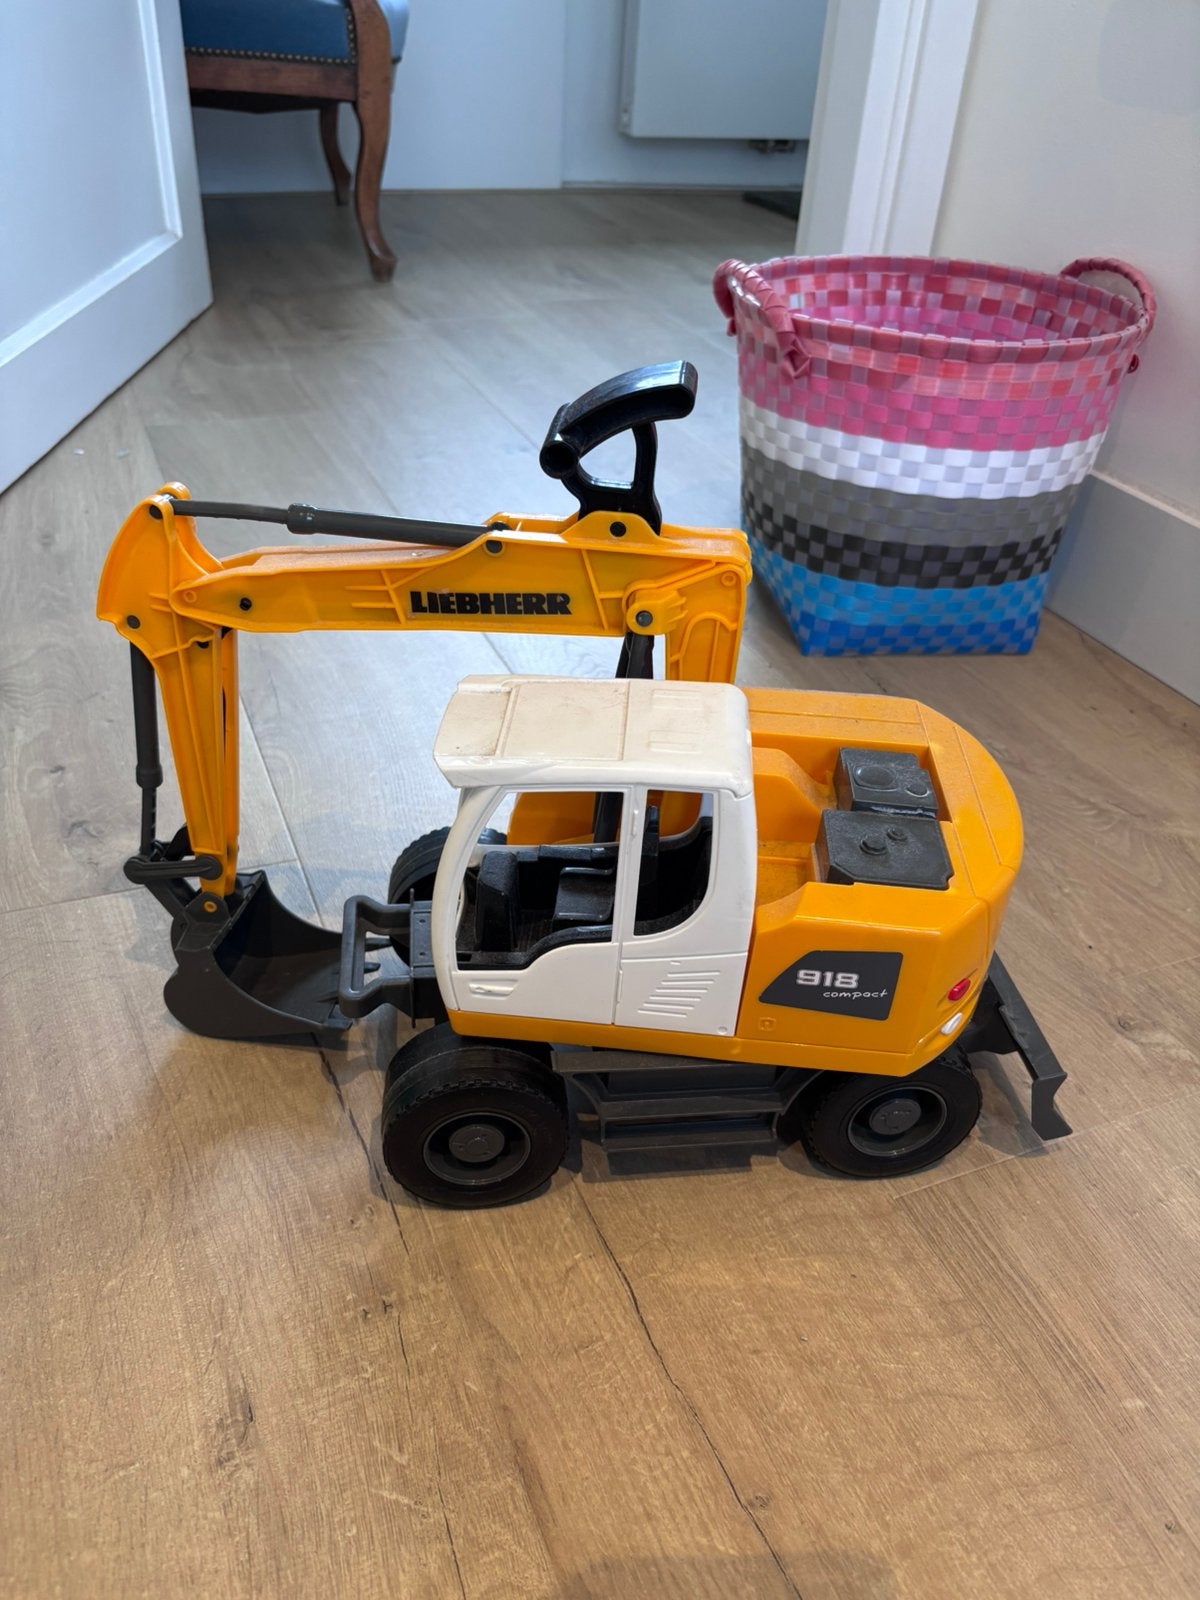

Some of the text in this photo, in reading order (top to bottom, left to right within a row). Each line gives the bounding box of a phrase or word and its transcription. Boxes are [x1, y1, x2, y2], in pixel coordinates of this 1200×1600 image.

[410, 591, 572, 615] LIEBHERR
[796, 969, 859, 988] 918
[823, 989, 888, 1000] compact
